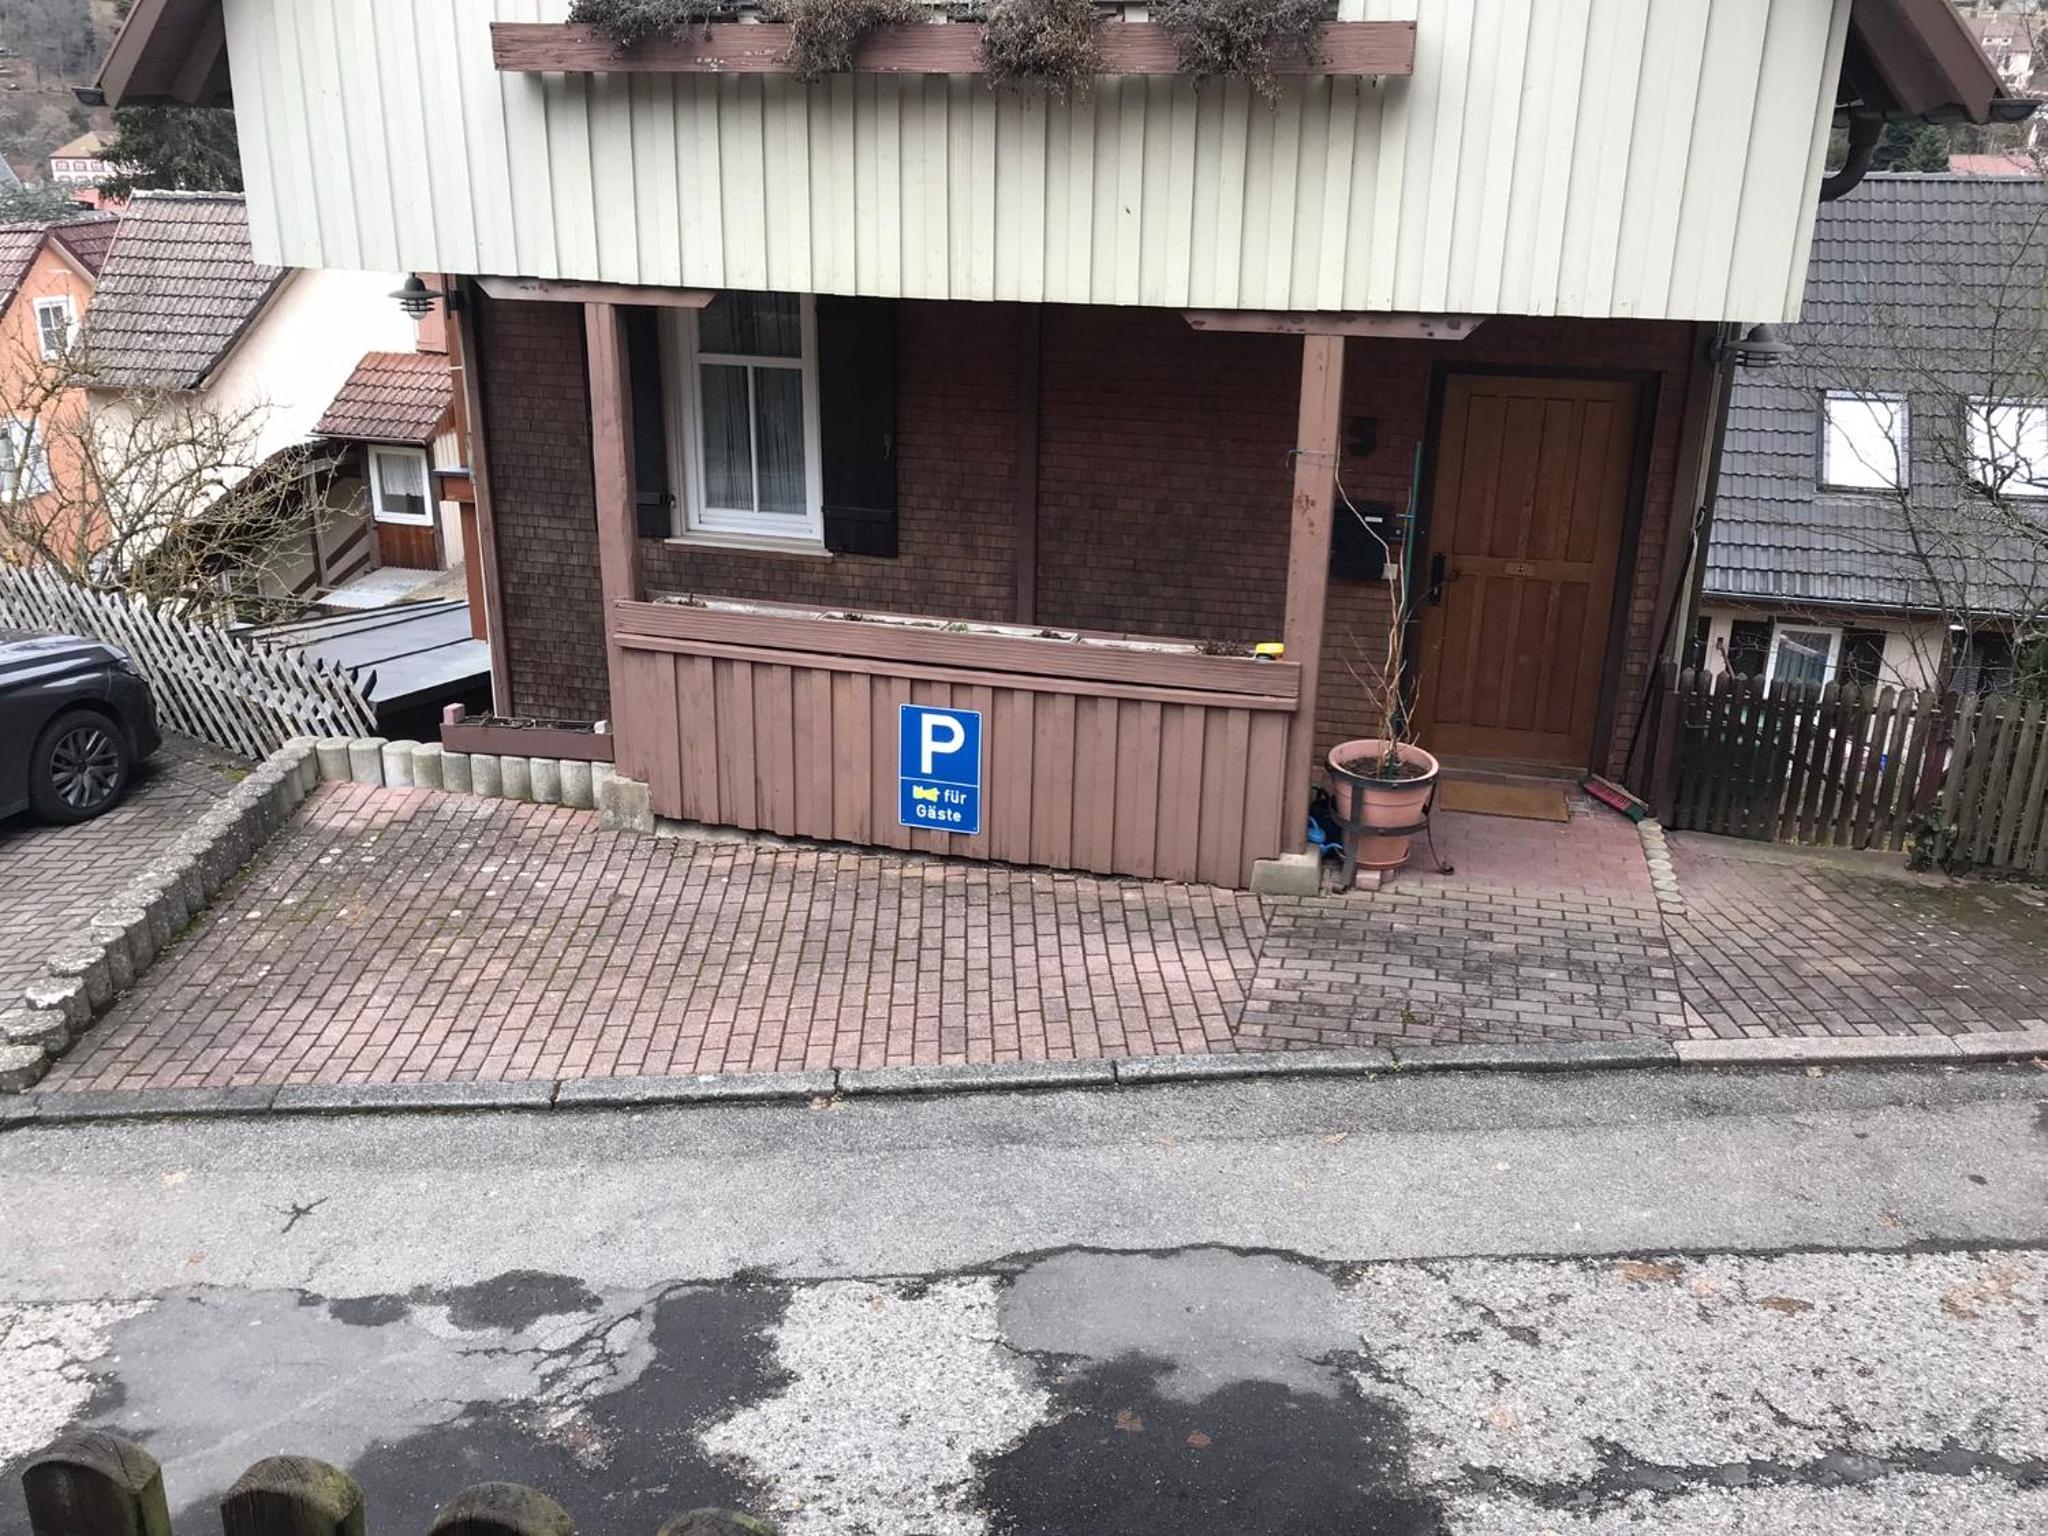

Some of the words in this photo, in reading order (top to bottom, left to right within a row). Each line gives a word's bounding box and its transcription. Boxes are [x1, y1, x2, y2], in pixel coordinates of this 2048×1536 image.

[920, 712, 965, 774] P
[944, 789, 967, 805] für
[916, 804, 962, 822] Gäste
